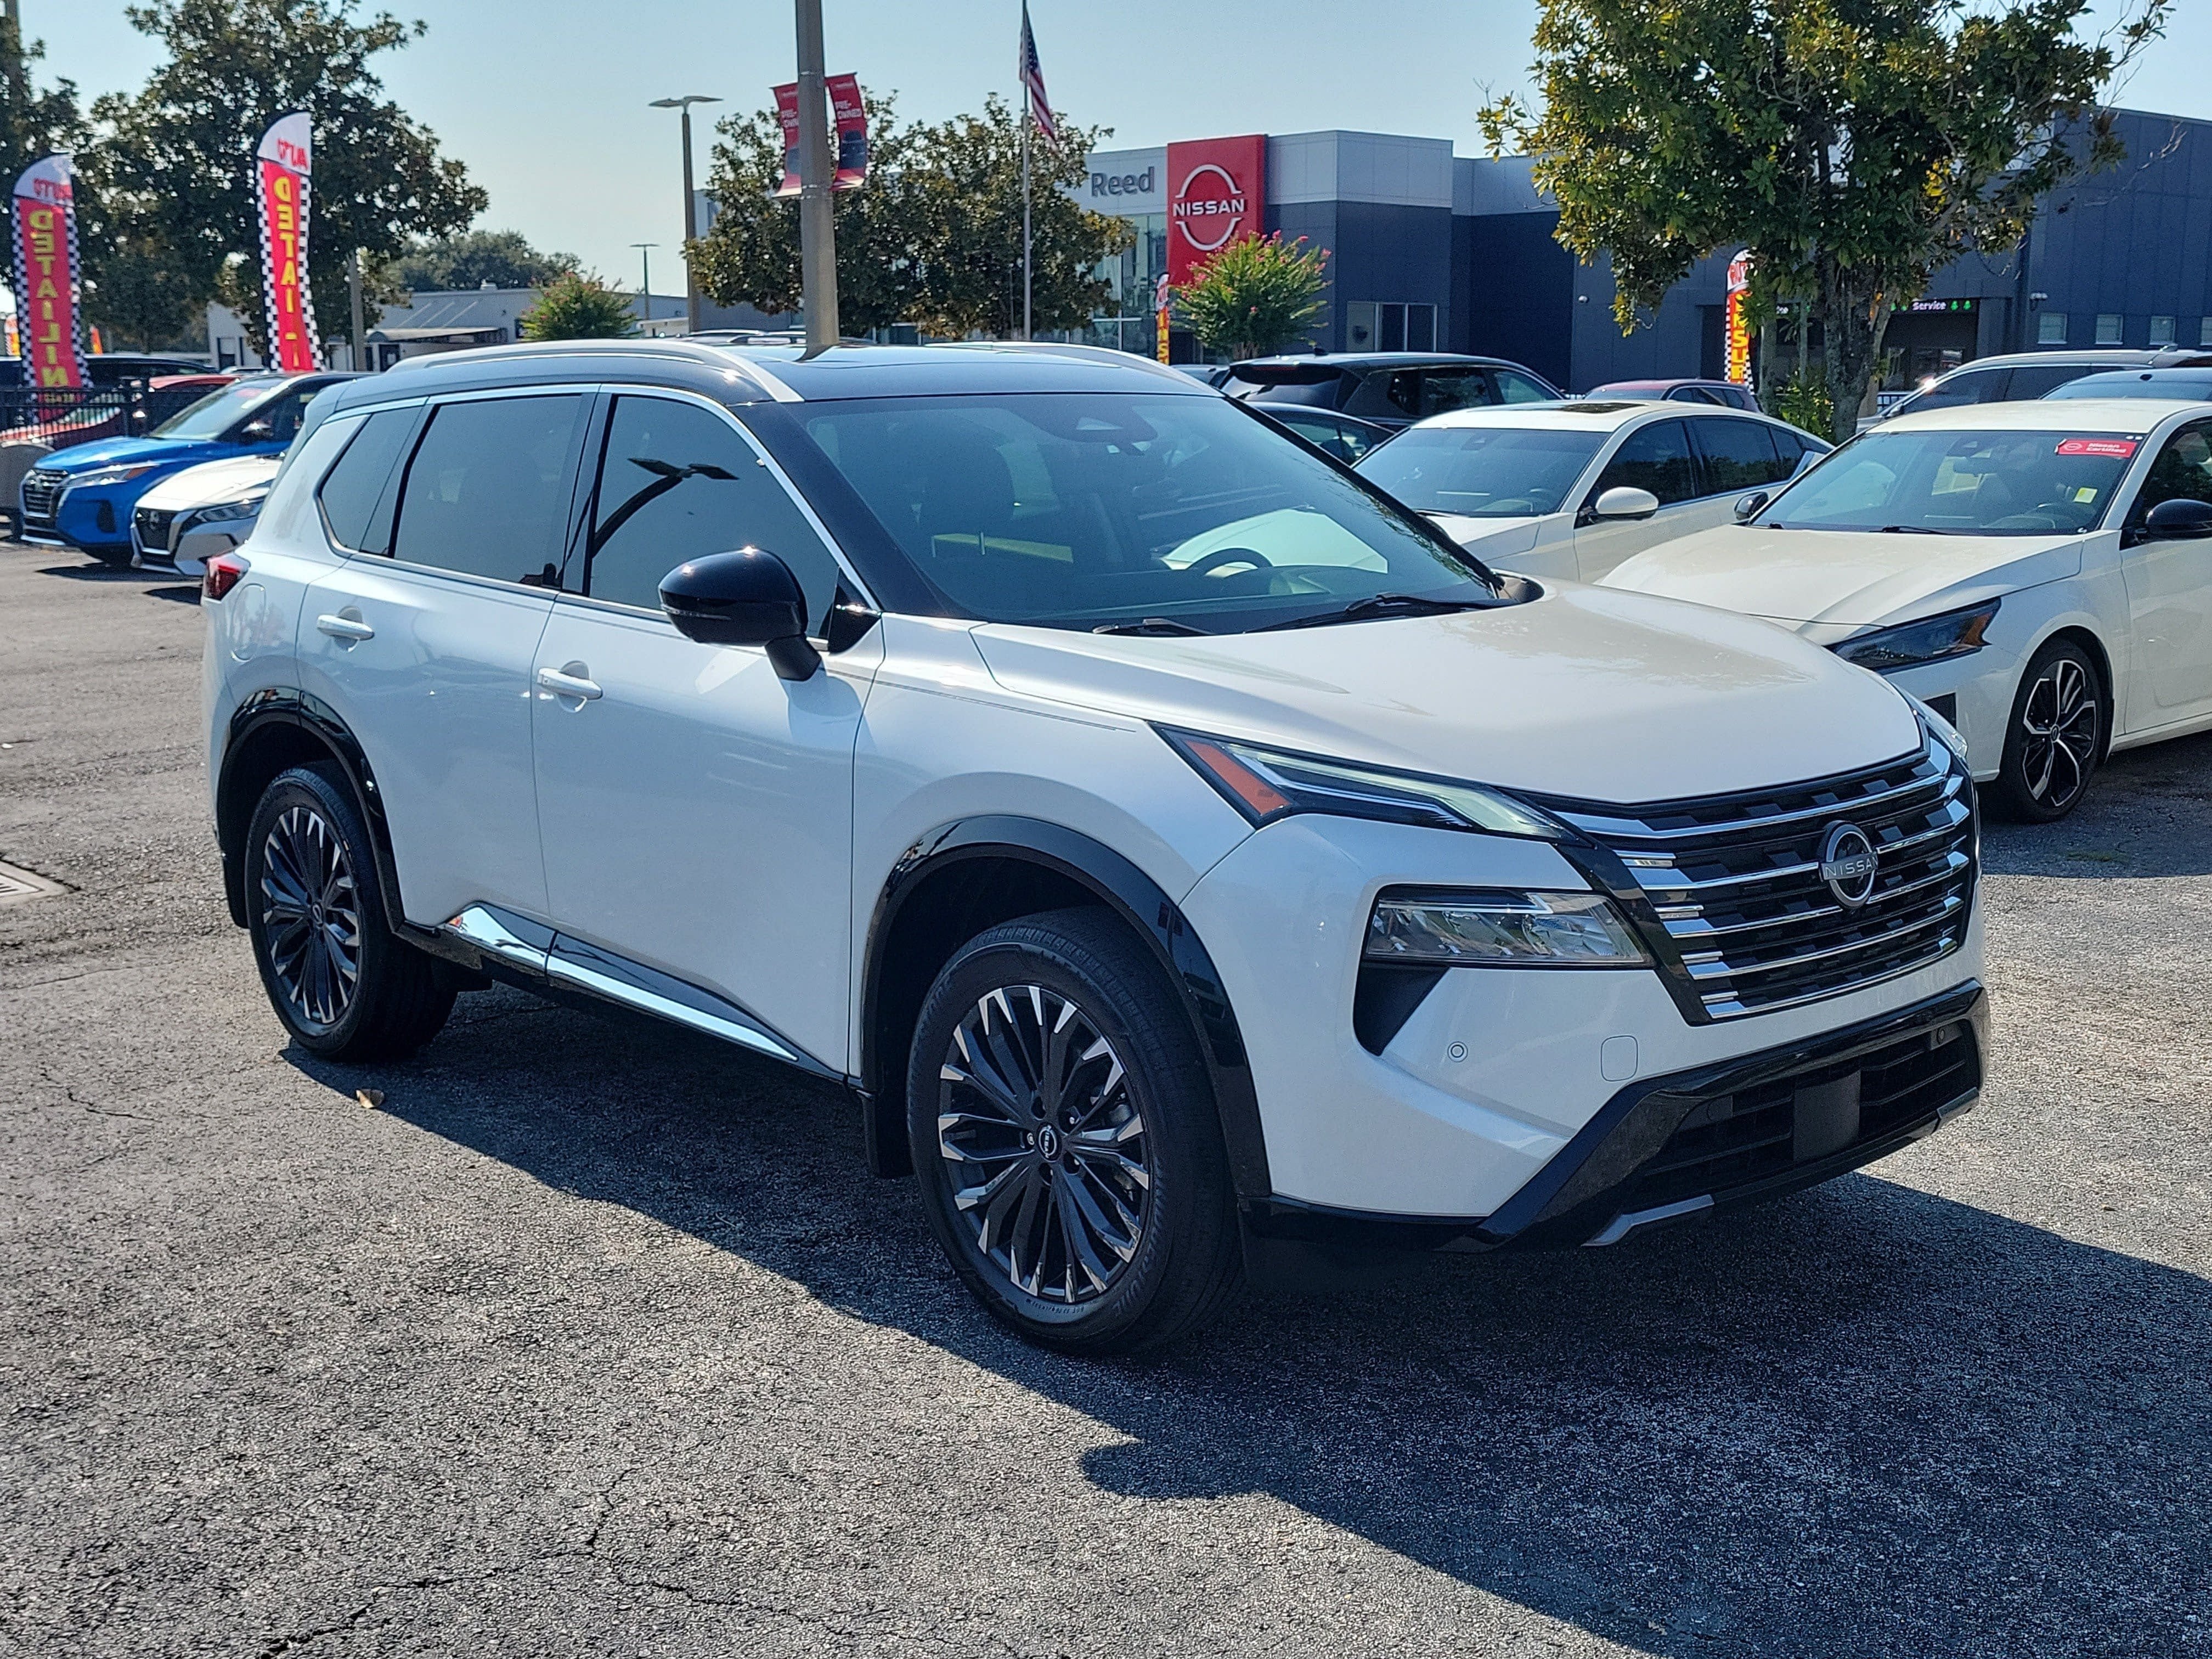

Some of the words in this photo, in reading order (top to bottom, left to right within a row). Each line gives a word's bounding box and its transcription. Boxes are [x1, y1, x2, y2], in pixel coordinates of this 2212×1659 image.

[1091, 166, 1155, 197] Reed
[1173, 199, 1245, 217] NISSAN
[1912, 300, 1947, 311] Service
[1825, 855, 1878, 877] NISSAN
